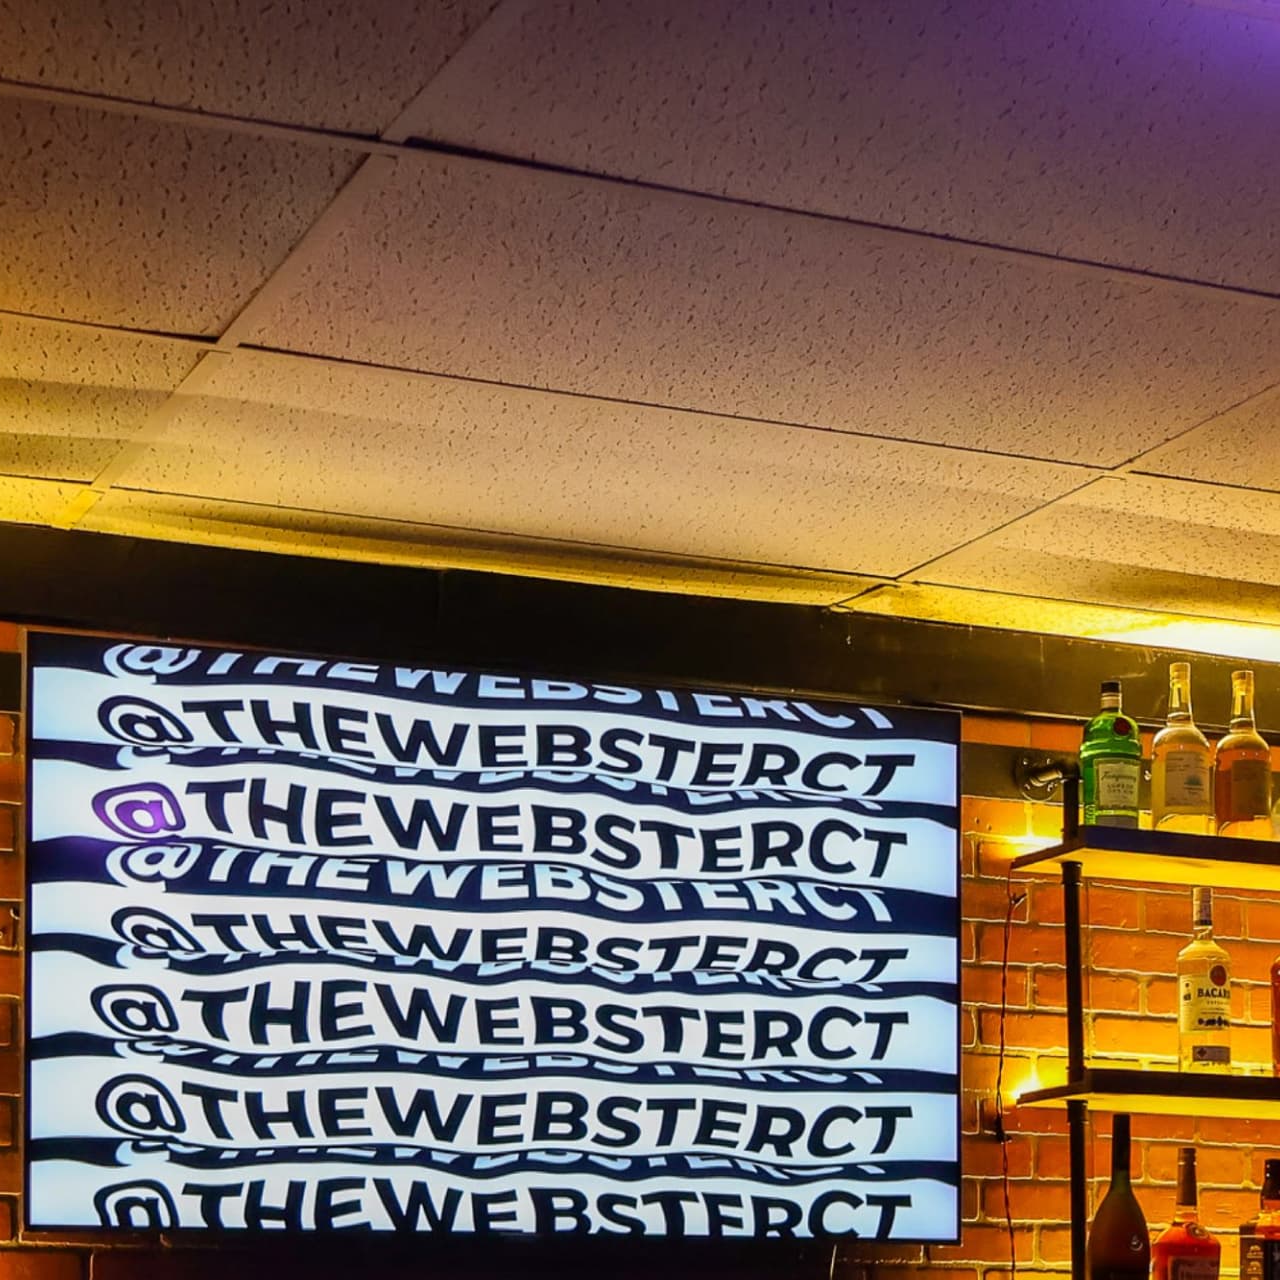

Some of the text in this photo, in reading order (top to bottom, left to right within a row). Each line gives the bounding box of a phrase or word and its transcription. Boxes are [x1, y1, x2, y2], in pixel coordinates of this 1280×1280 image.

[98, 694, 915, 796] @THEWEBSTERCT
[92, 777, 908, 878] @THEWEBSTERCT
[111, 907, 909, 983] @THEWEBSTERCT
[90, 979, 909, 1061] @THEWEBSTERCT
[95, 1073, 913, 1158] @THEWEBSTERCT
